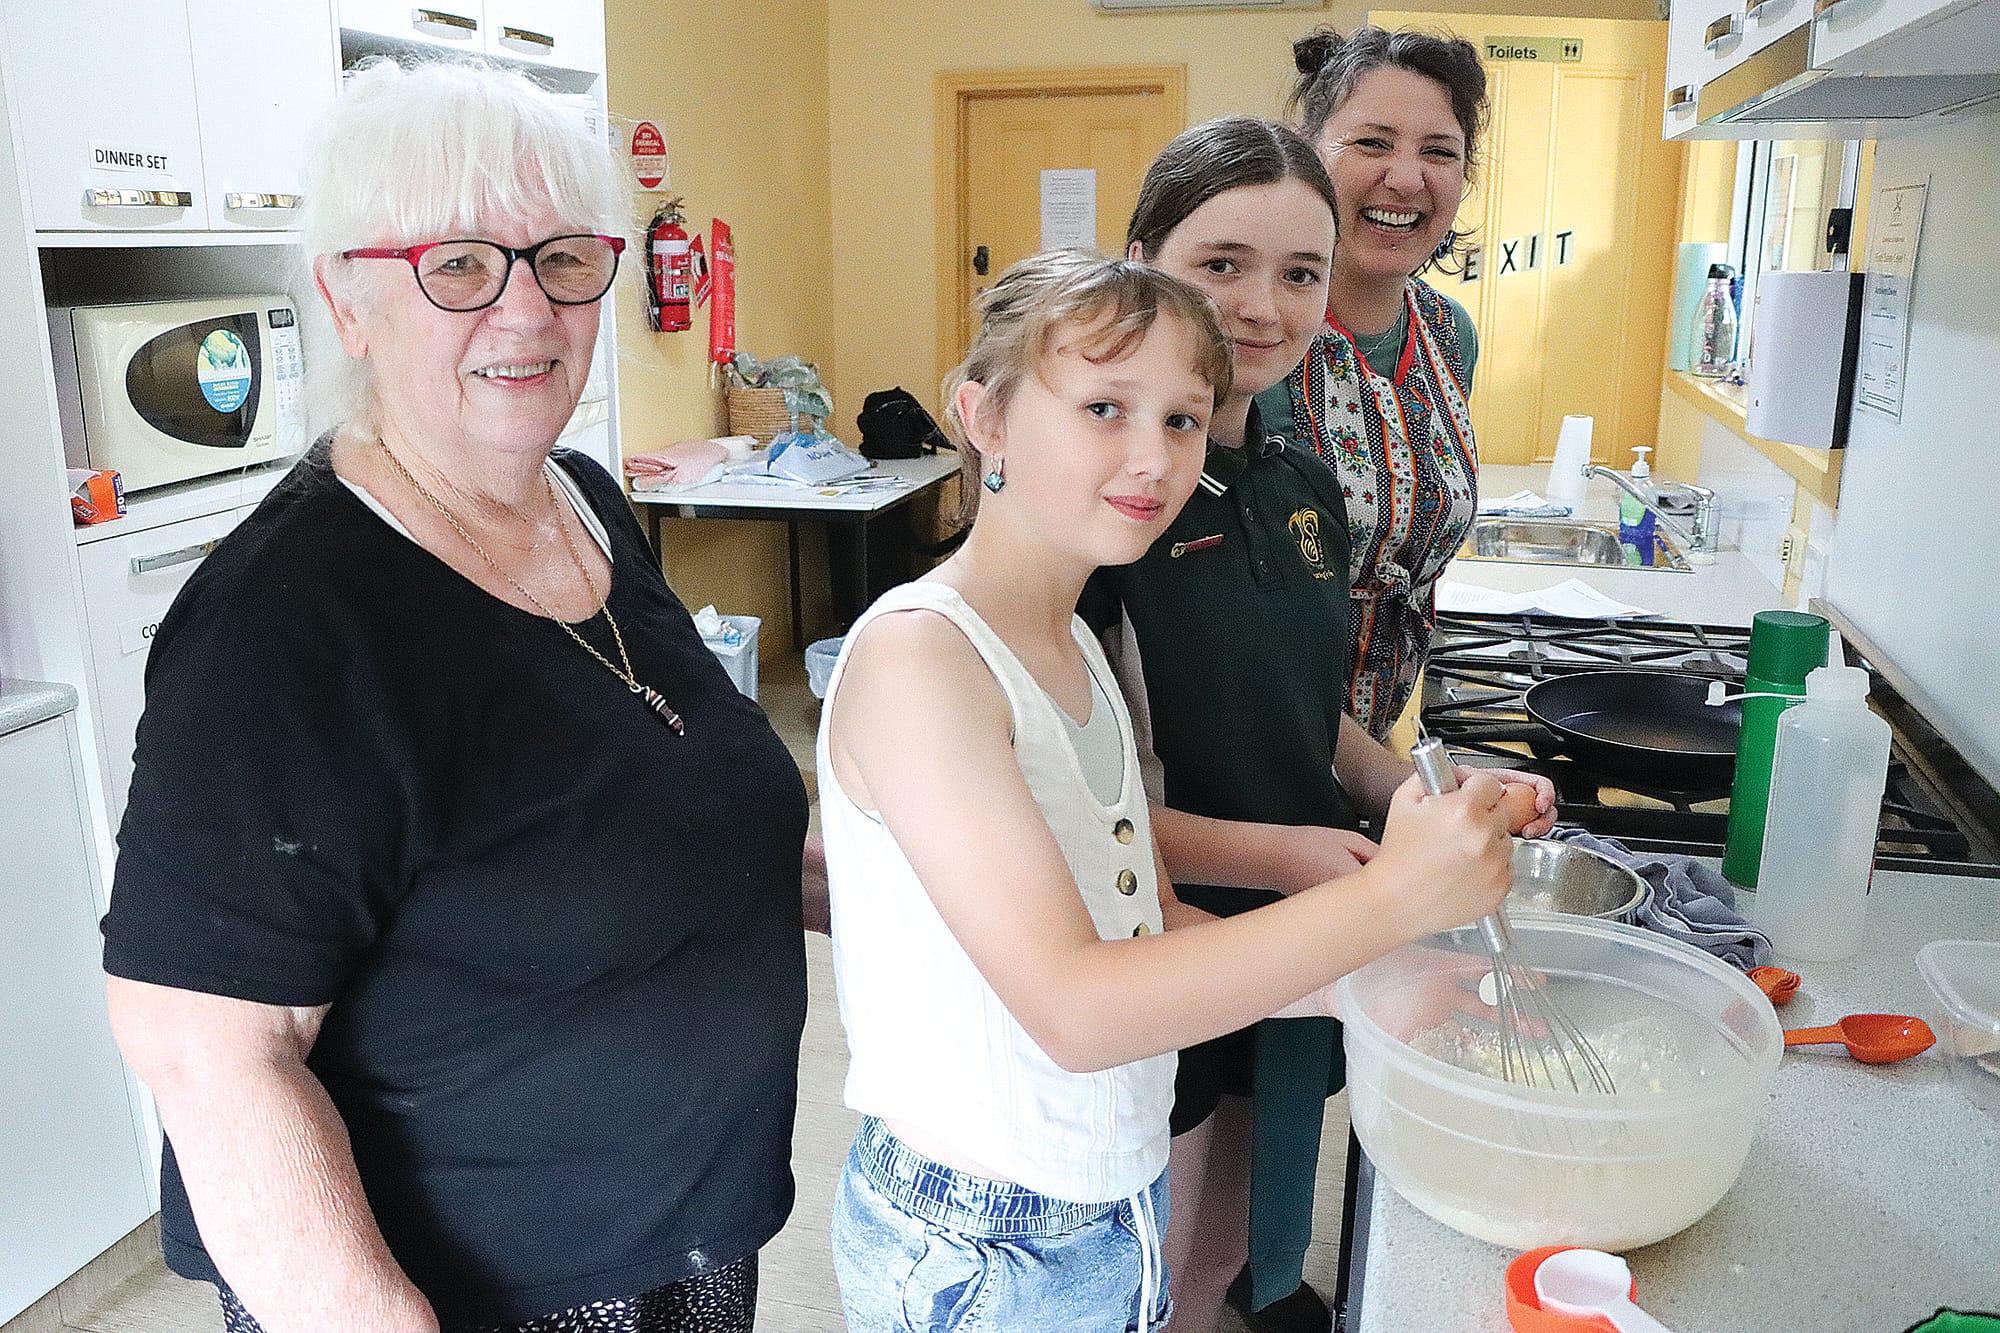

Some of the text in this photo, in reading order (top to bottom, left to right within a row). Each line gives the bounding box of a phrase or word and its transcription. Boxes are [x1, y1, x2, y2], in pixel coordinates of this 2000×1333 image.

[1487, 44, 1538, 60] Toilets
[94, 148, 168, 170] DINNER SET
[1463, 230, 1573, 281] EXIT
[142, 623, 161, 639] CO
